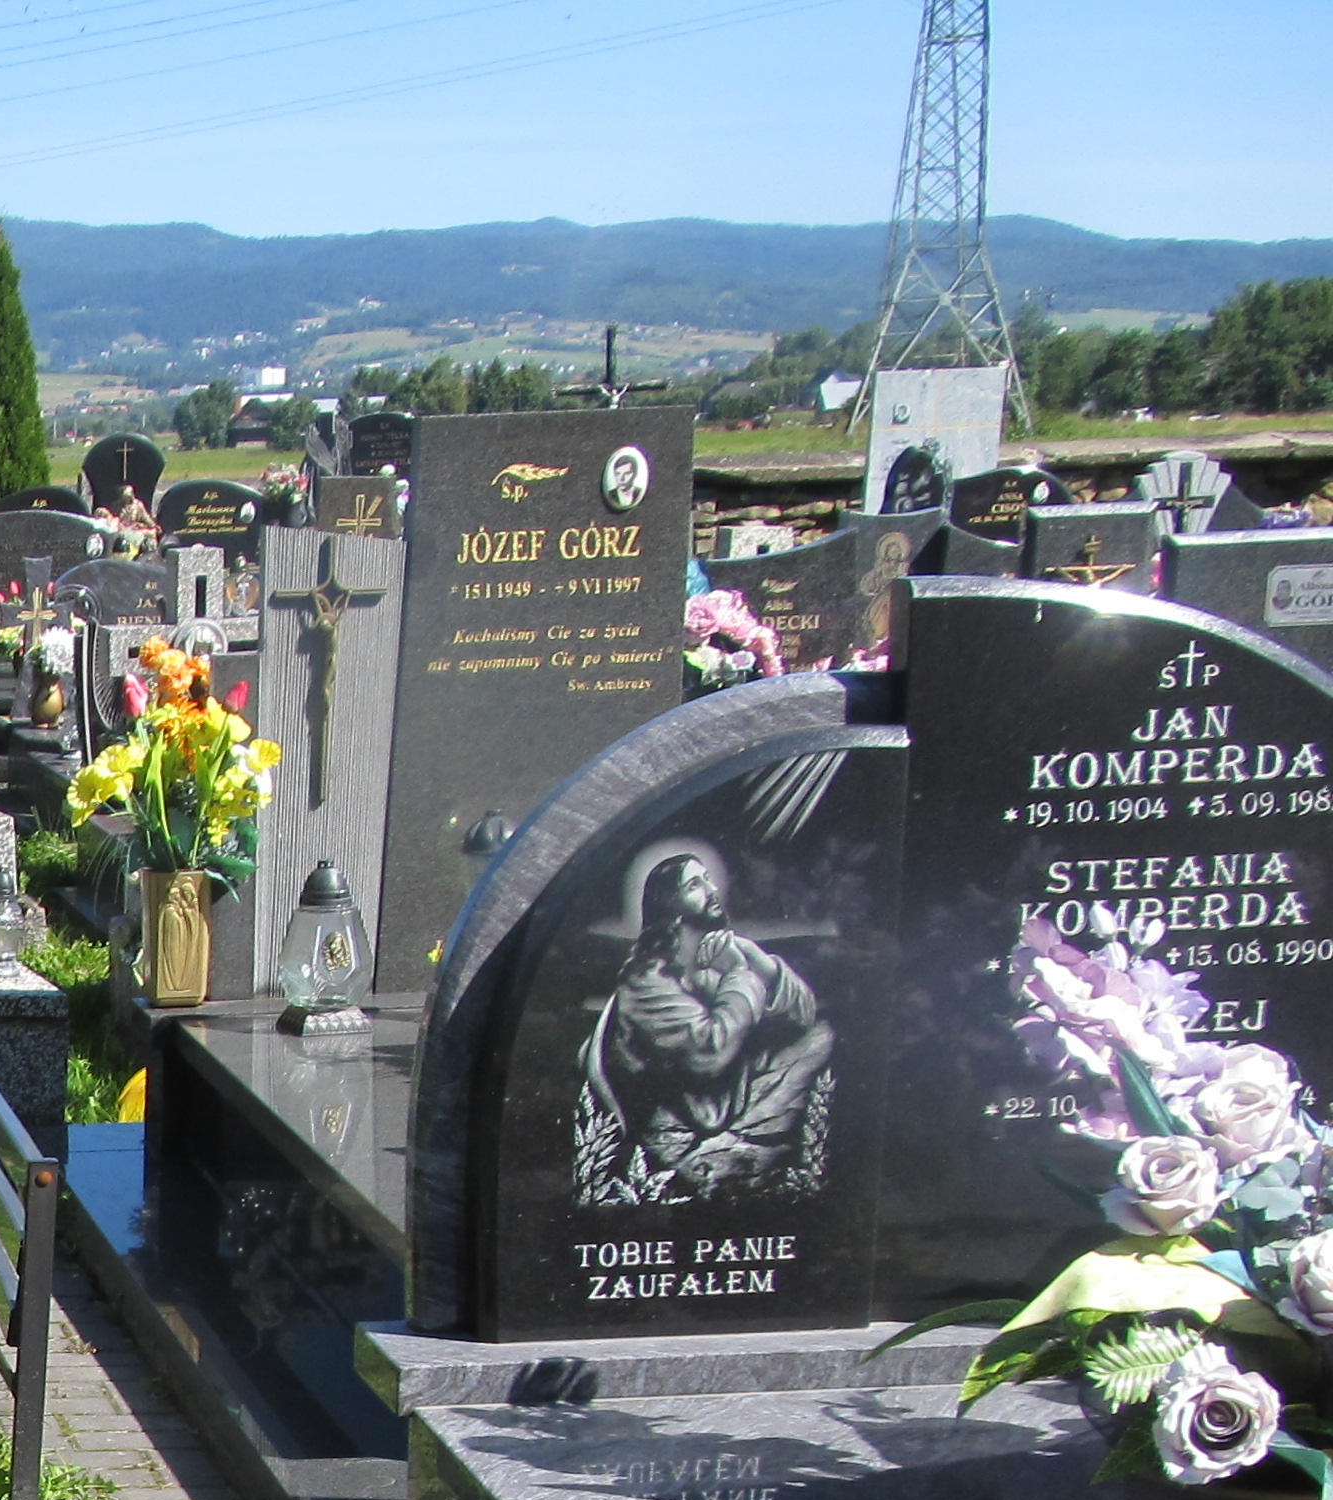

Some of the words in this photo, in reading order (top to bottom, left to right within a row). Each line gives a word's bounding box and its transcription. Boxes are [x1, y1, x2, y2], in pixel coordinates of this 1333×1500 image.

[457, 526, 546, 564] JÓZEF
[559, 521, 642, 559] GÓRZ
[497, 581, 532, 598] 1949
[606, 576, 642, 594] 1997
[582, 653, 602, 669] po
[1131, 705, 1233, 743] JAN
[1028, 743, 1326, 790] KOMPERDA
[1026, 801, 1059, 828] 19.
[1065, 799, 1100, 824] 10.
[1107, 797, 1168, 824] 1904
[1241, 790, 1281, 818] 09.
[1287, 786, 1333, 817] 198
[1045, 852, 1293, 895] STEFANIA
[1188, 943, 1219, 967] 15.
[1227, 939, 1268, 965] 08.
[1274, 938, 1333, 966] 1990
[574, 1240, 676, 1268] TOBIE
[694, 1235, 797, 1264] PANIE
[588, 1268, 777, 1300] ZAUFAŁEM
